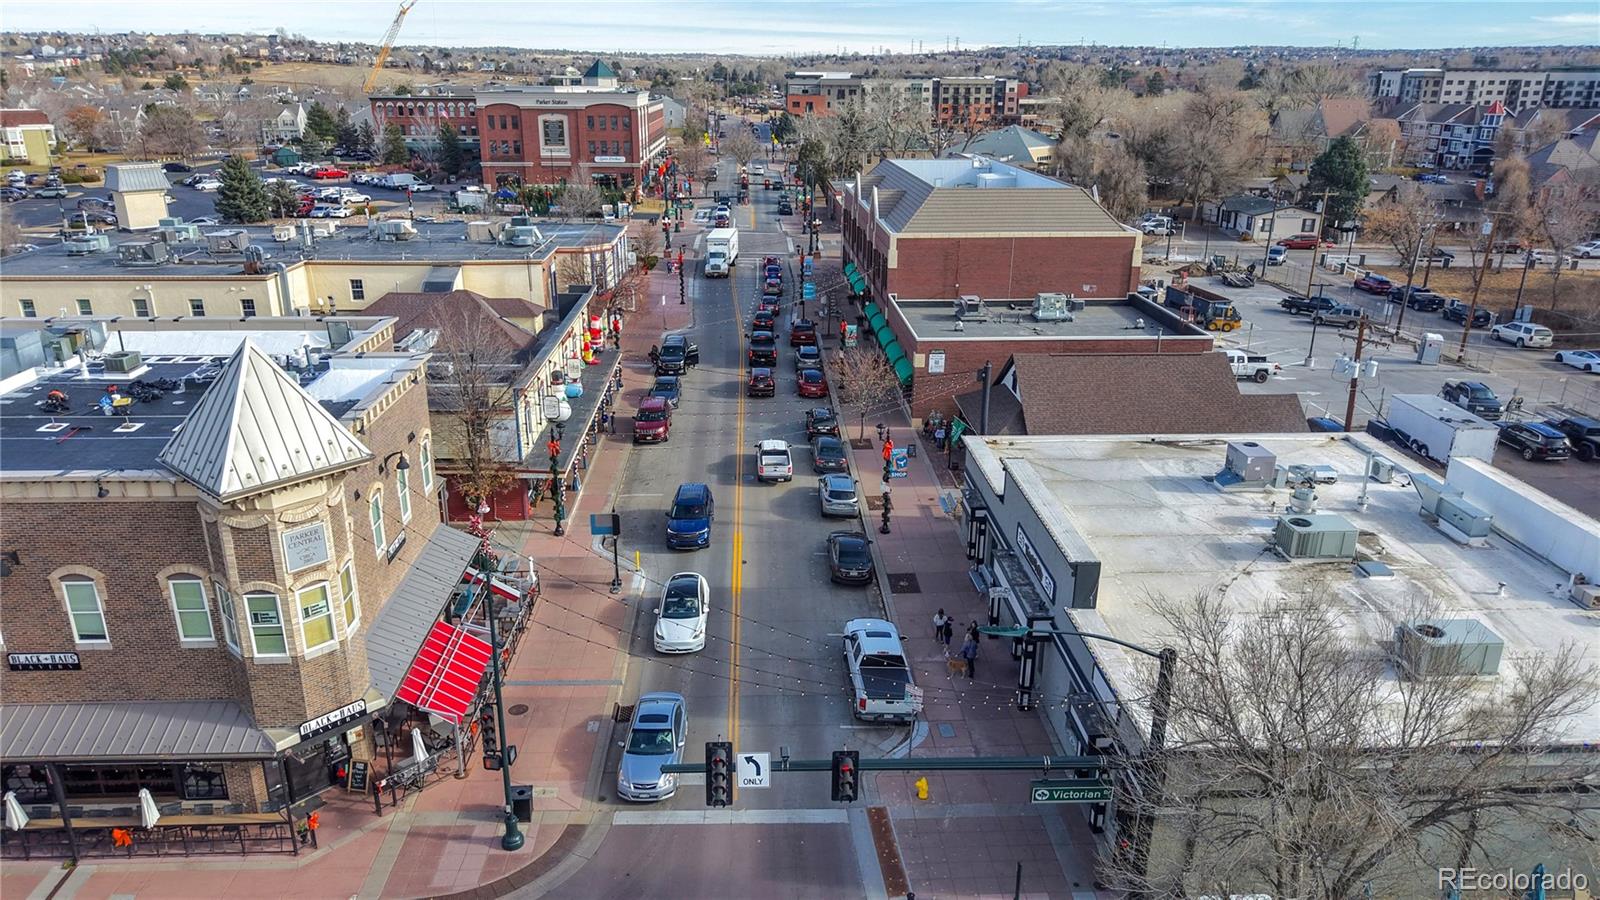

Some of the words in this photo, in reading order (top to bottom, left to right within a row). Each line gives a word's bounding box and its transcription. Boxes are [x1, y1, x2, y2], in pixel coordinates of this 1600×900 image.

[288, 535, 322, 549] CENTRAL
[289, 529, 319, 542] PARKER
[10, 655, 42, 664] BLACK
[49, 654, 76, 663] HAUS
[302, 714, 333, 734] BLACK
[339, 701, 364, 718] HAUS
[1053, 790, 1101, 799] Victorian
